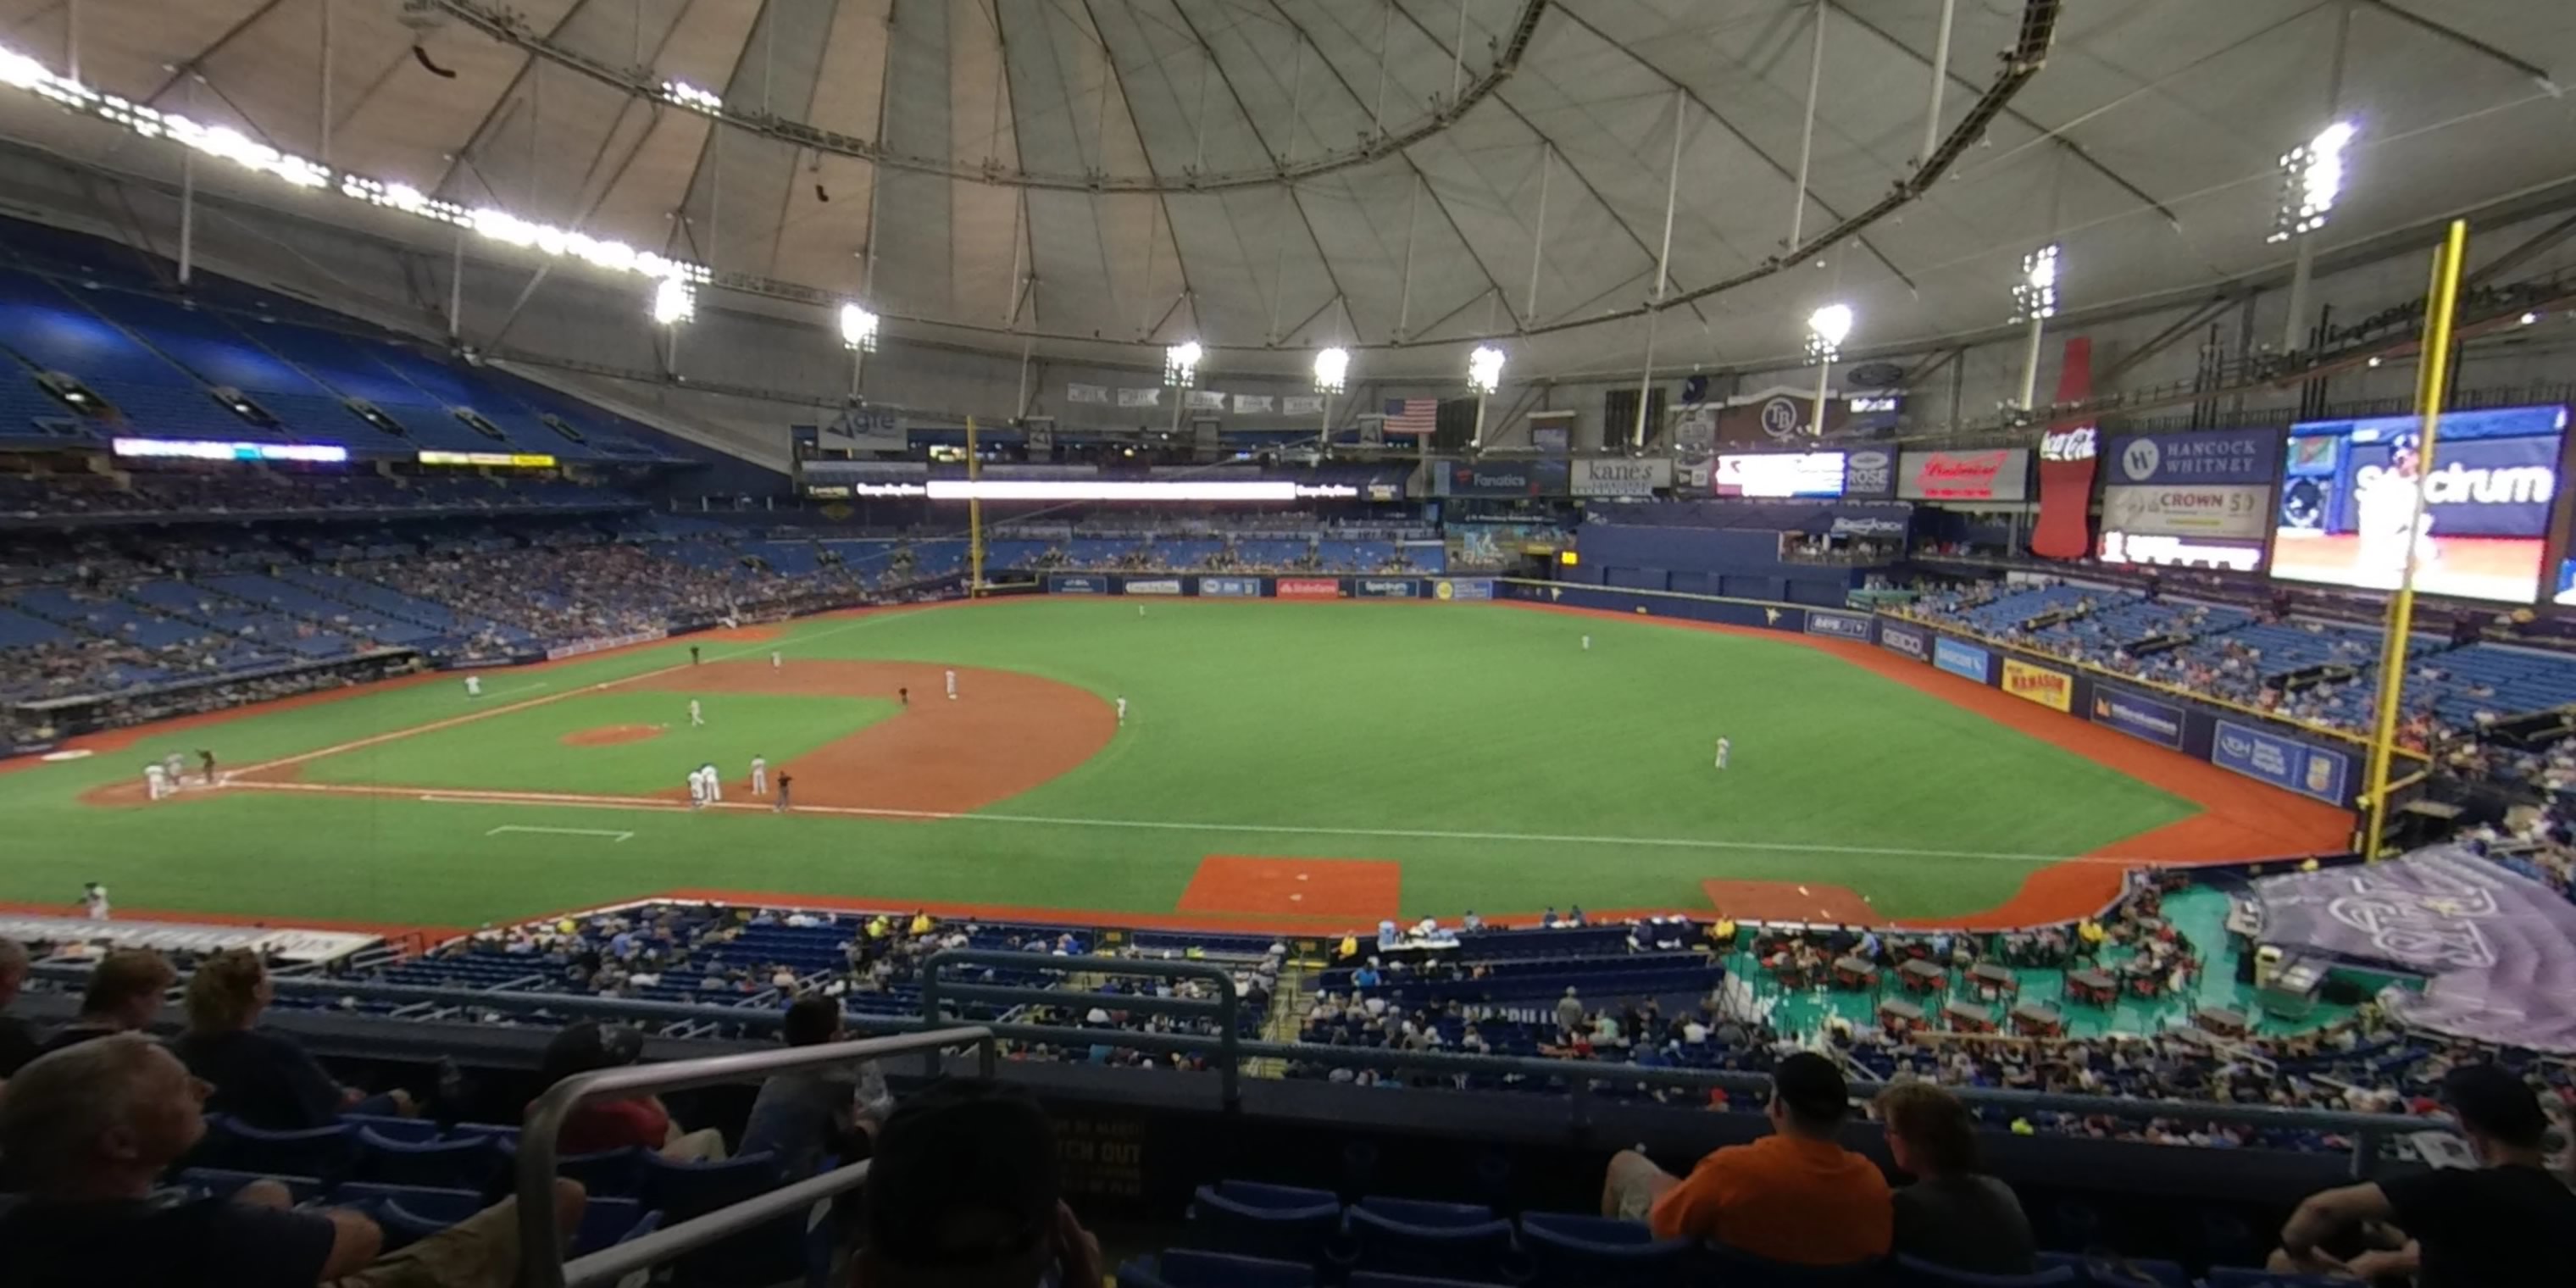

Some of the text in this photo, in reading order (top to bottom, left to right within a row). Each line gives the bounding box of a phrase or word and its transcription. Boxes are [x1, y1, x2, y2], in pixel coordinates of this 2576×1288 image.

[2167, 441, 2257, 456] HANCOCK
[2166, 458, 2254, 473] WHITNEY
[1473, 473, 1526, 487] Fanatics
[1848, 469, 1889, 484] ROSE
[2162, 492, 2223, 507] CROWN
[1883, 628, 1923, 654] GEICO
[1101, 1141, 1141, 1164] OUT
